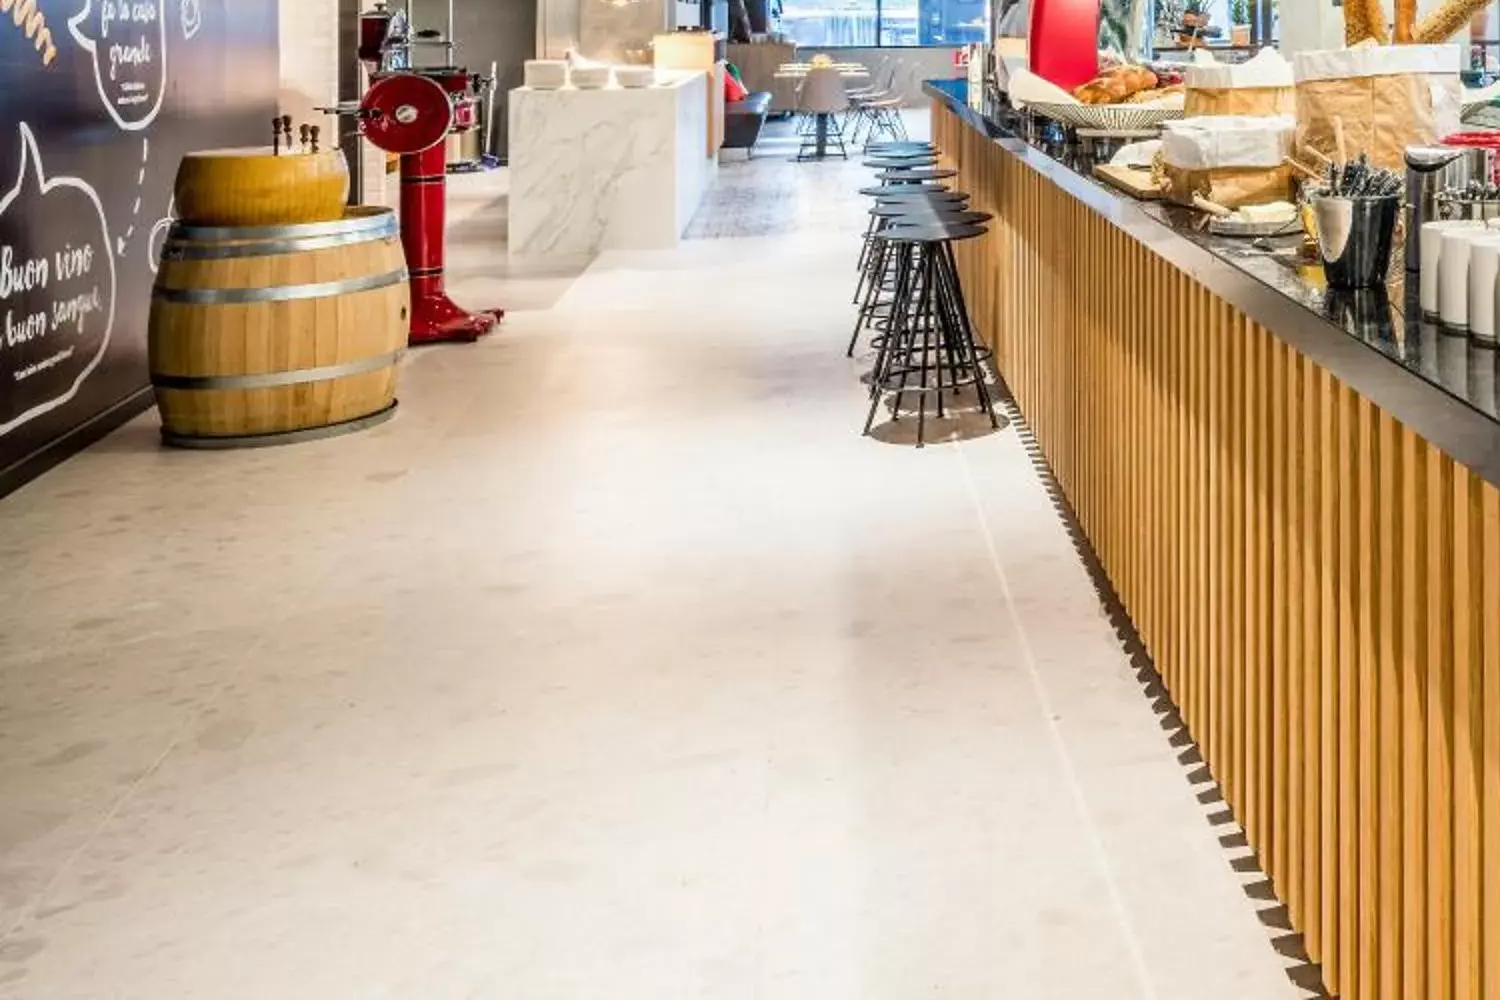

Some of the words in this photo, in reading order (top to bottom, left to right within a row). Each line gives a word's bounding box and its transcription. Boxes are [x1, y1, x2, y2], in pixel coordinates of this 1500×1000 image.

[109, 34, 151, 81] grande
[0, 245, 49, 299] Buon
[55, 243, 95, 281] vino
[6, 309, 47, 347] buon
